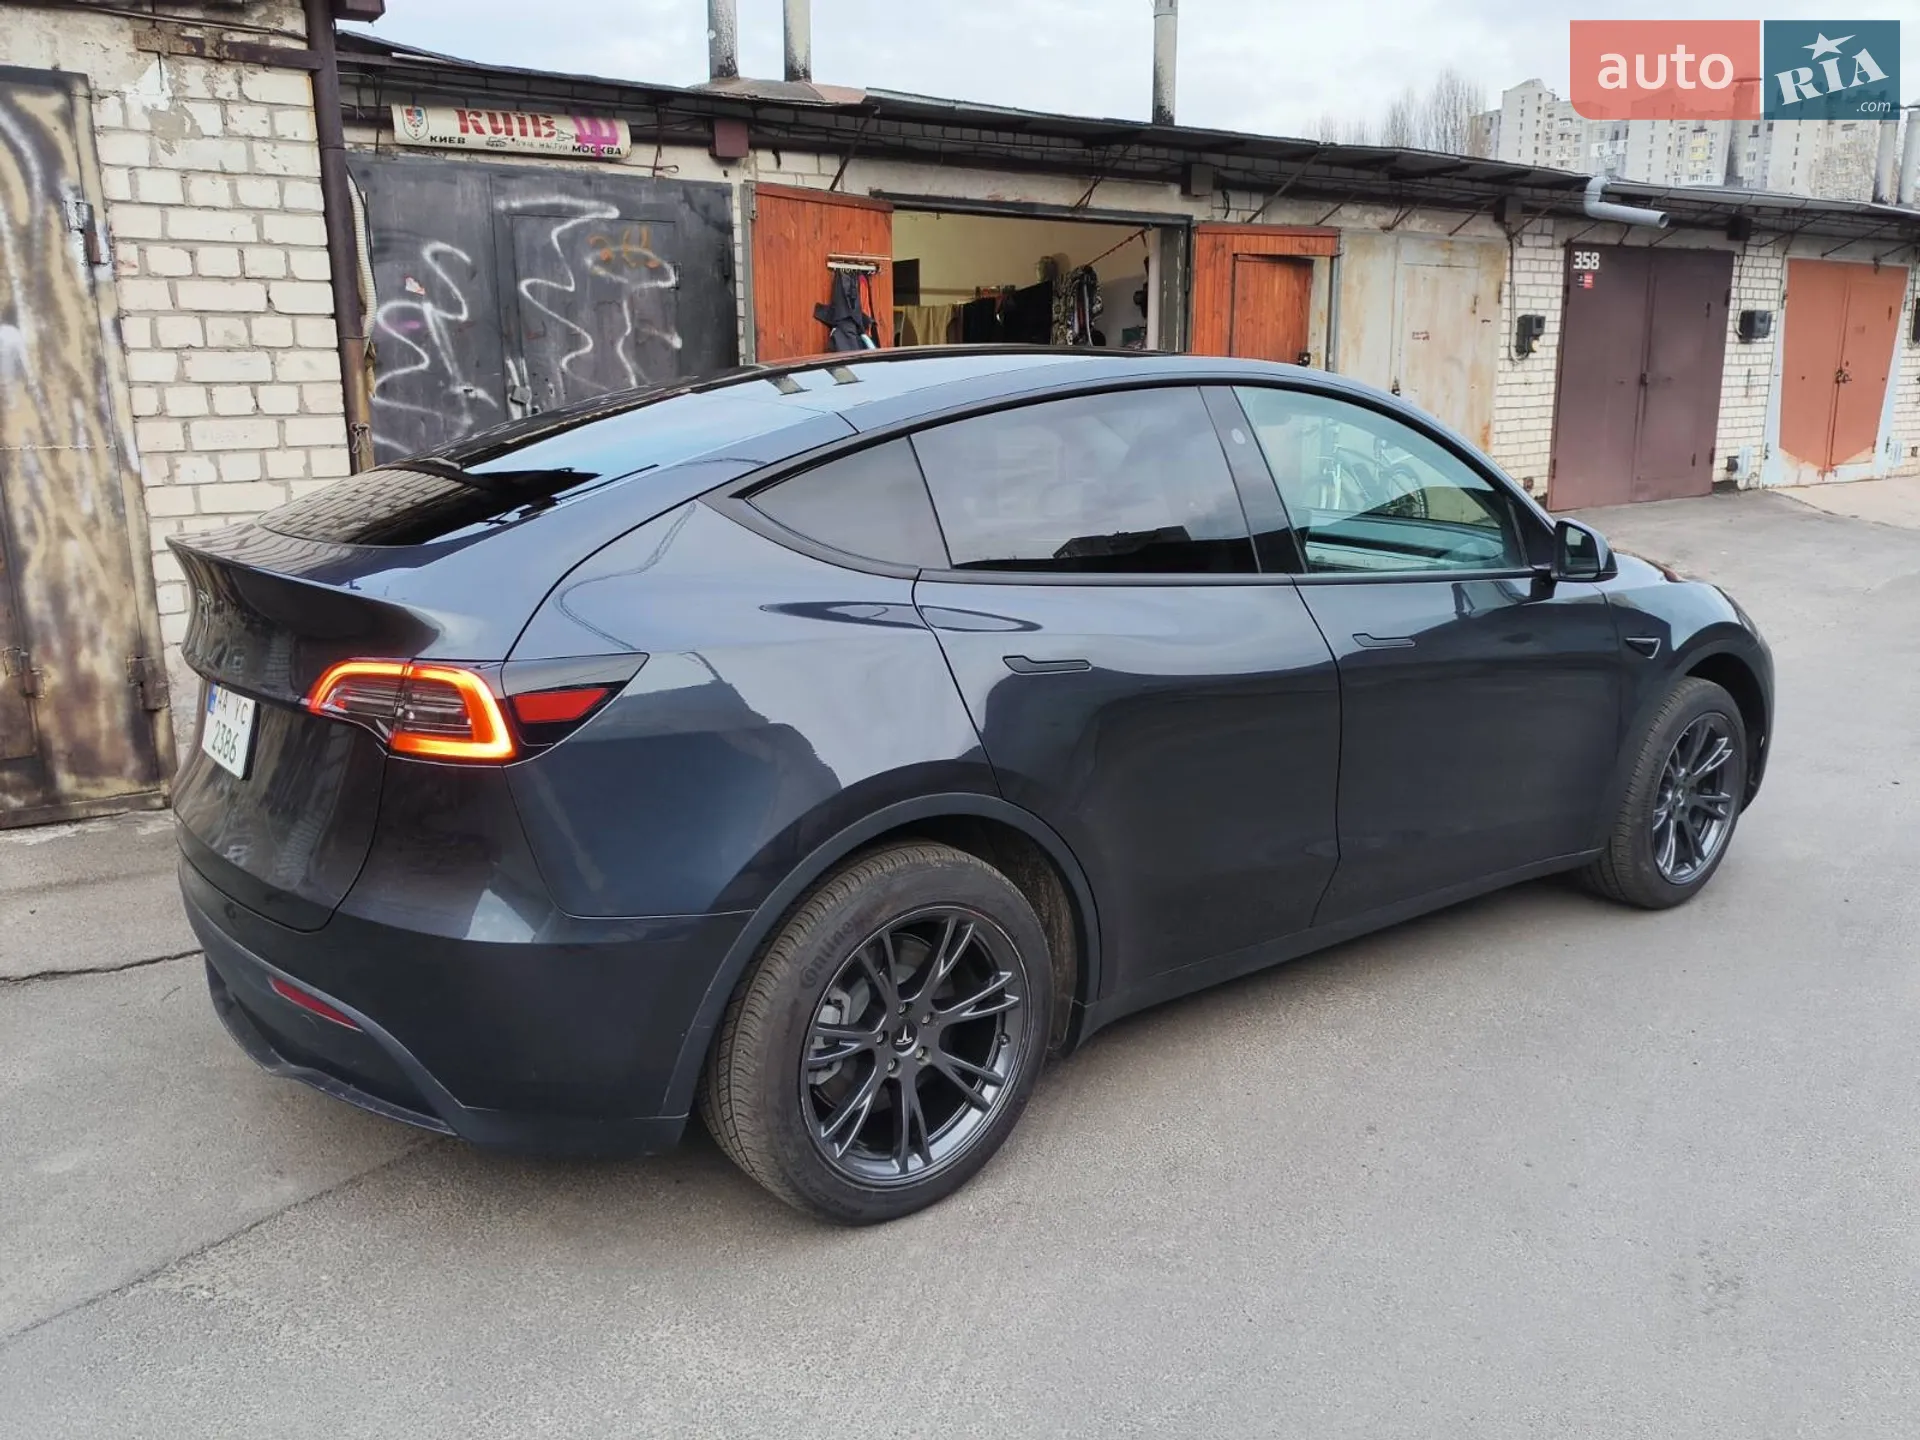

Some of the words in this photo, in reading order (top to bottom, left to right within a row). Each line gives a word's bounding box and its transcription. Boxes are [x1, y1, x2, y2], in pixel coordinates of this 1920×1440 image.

[430, 135, 466, 144] КИЕВ
[571, 143, 622, 155] МОСКВА
[1573, 251, 1600, 270] 358
[212, 719, 239, 764] 2386
